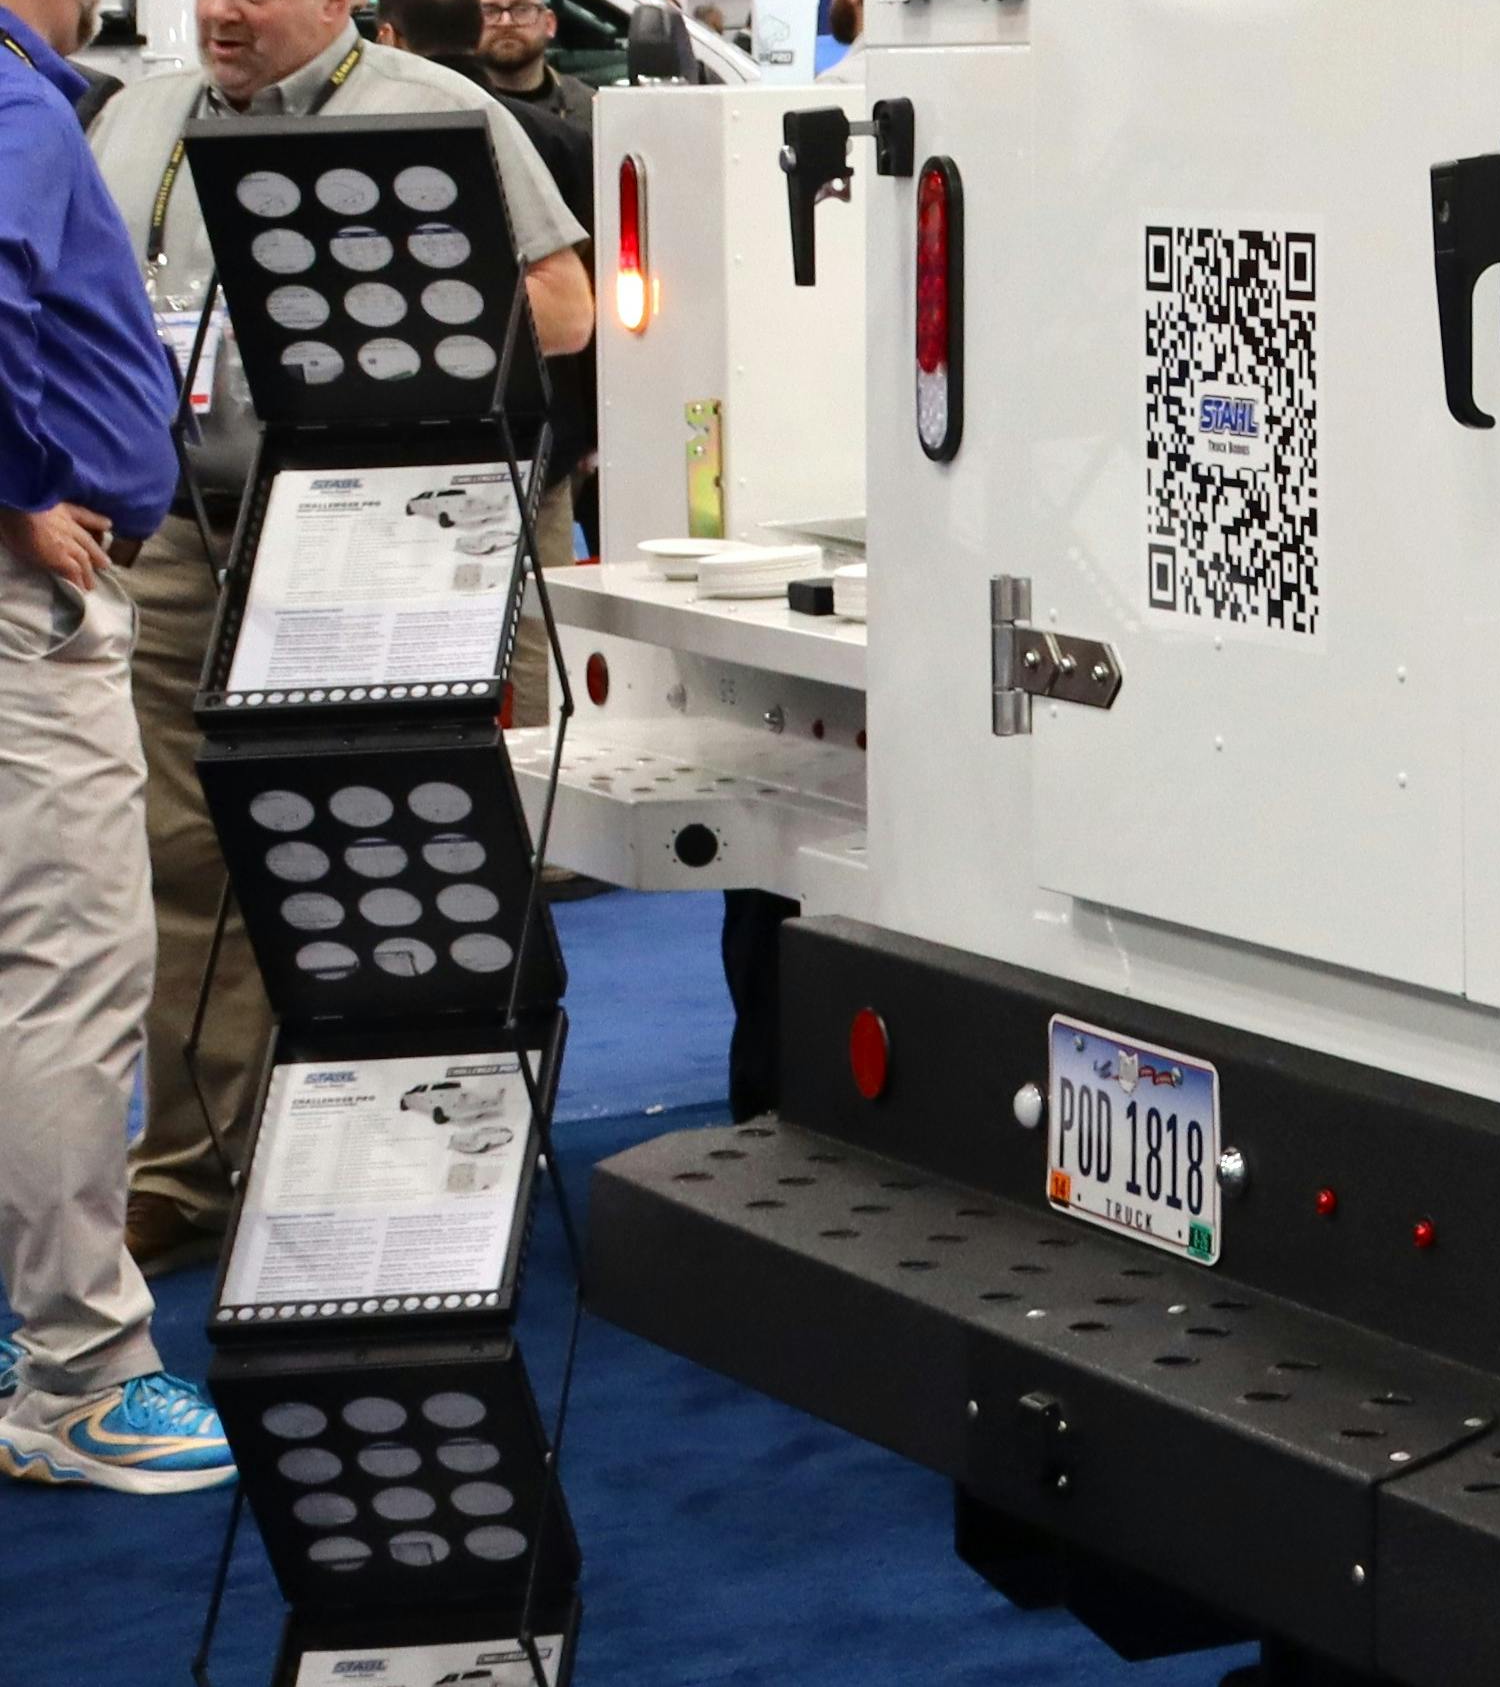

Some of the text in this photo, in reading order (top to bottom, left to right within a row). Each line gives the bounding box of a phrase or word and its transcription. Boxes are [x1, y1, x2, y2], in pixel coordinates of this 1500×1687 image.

[1199, 395, 1260, 439] STAHL
[1059, 1075, 1205, 1217] POD 1818
[1105, 1197, 1153, 1233] TRUCK
